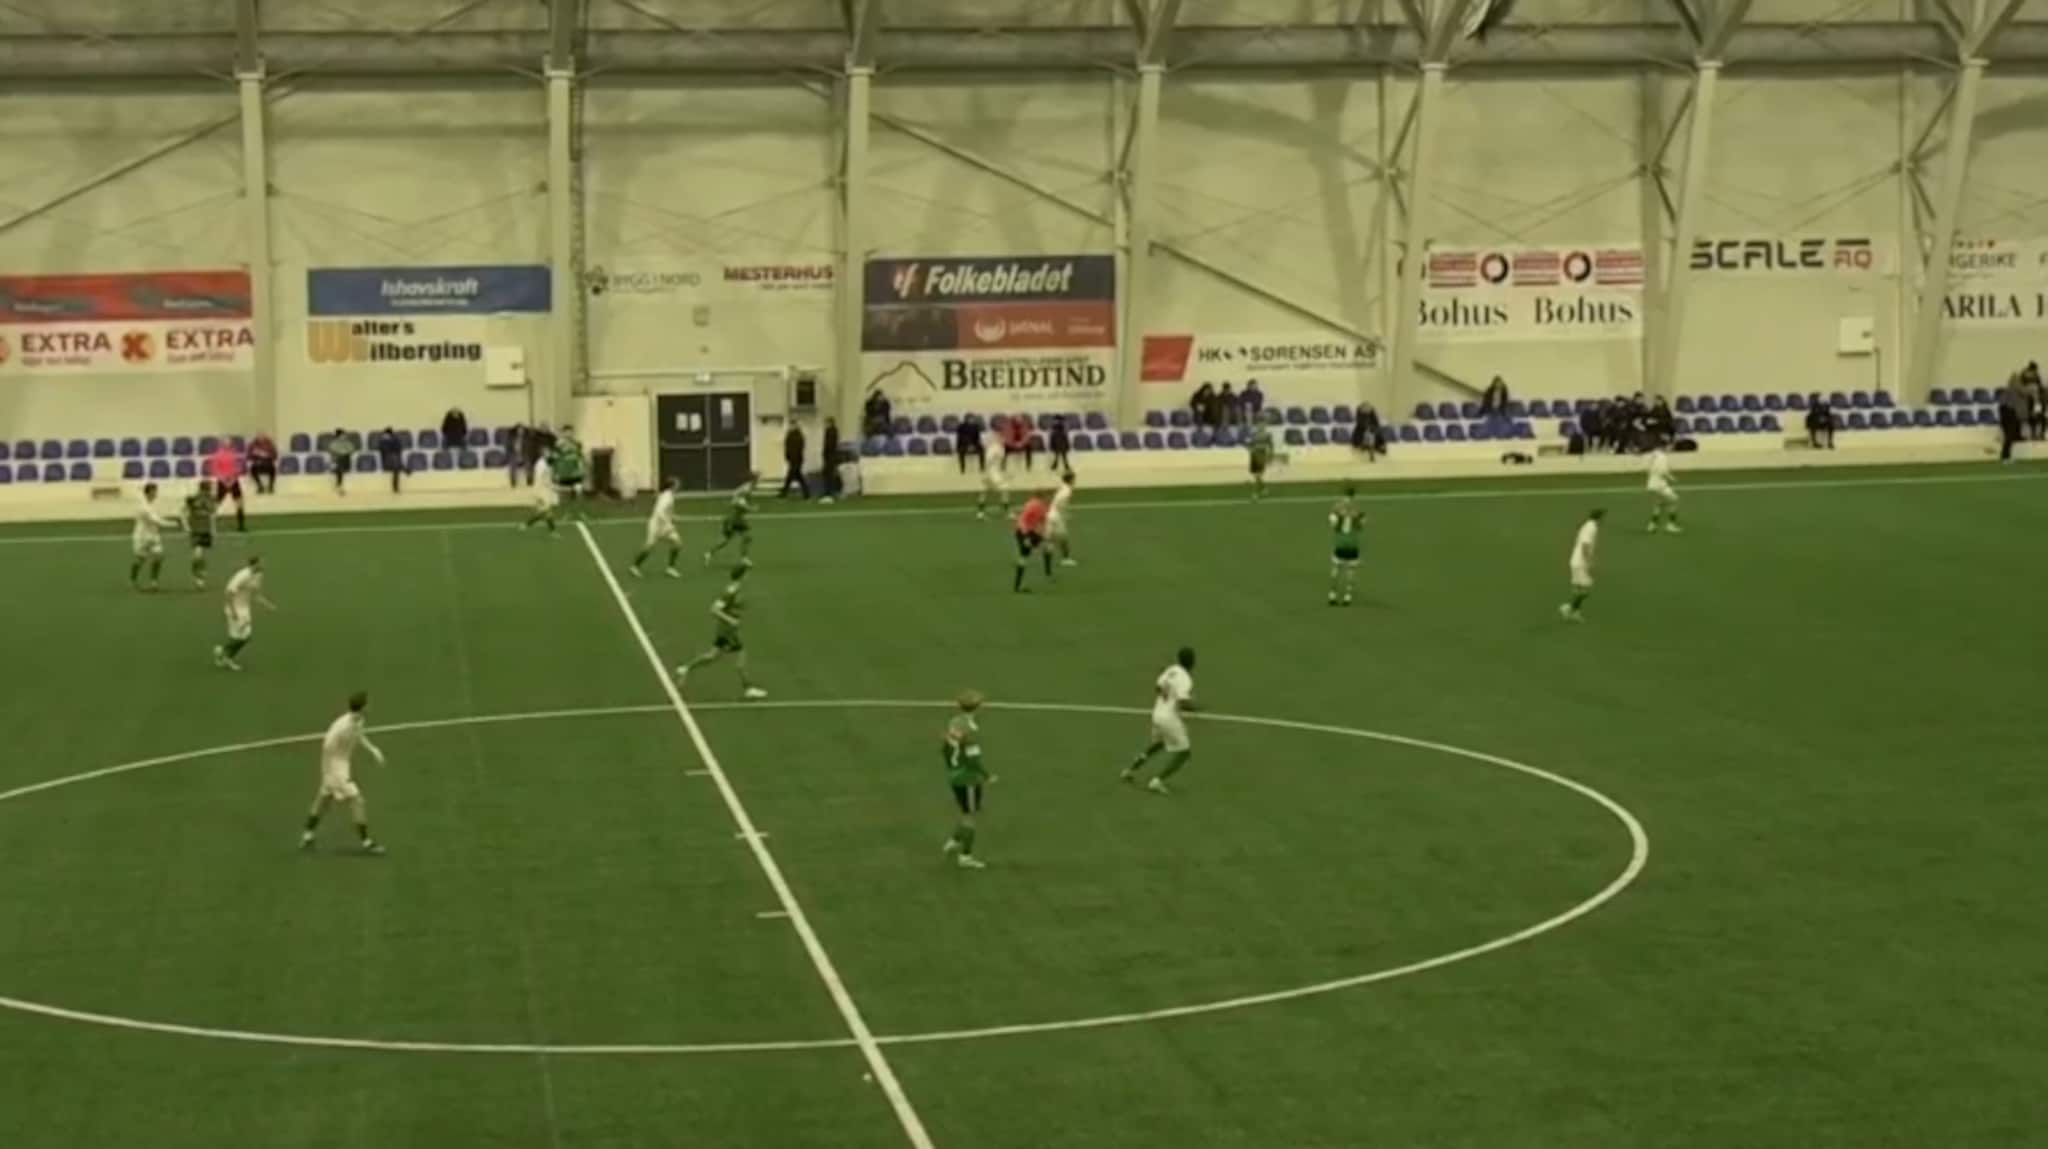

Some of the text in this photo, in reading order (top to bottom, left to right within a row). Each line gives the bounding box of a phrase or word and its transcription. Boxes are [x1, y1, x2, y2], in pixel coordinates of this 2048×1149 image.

[1691, 239, 1824, 269] SCALE
[723, 265, 833, 281] MESTERHUS
[924, 262, 1073, 295] Folkebladet
[1535, 297, 1633, 324] Bohus
[21, 328, 255, 352] EXTRA EXTRA
